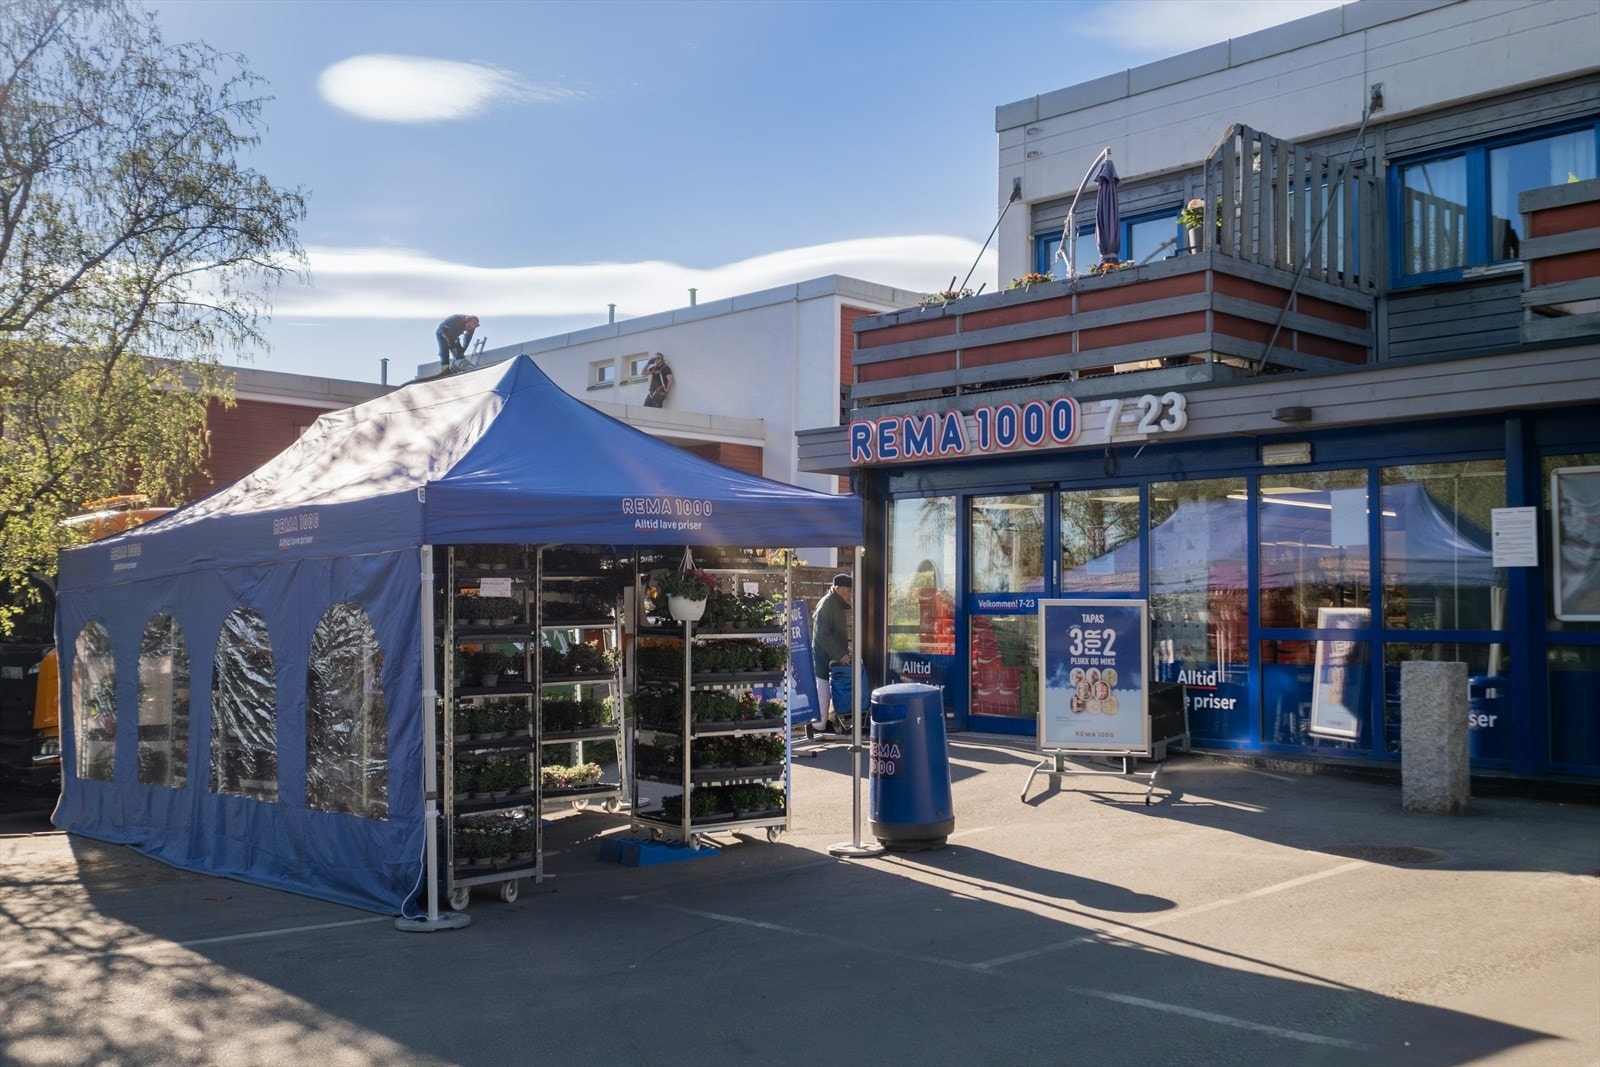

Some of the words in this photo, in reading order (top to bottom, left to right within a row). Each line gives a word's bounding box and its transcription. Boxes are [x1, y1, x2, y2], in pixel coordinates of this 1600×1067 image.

[848, 408, 967, 464] REMA
[975, 395, 1080, 451] 1000
[1100, 391, 1188, 437] 7-23
[622, 498, 672, 515] REMA
[675, 499, 713, 516] 1000
[634, 518, 659, 529] Alltid
[660, 519, 677, 529] lave
[678, 520, 703, 531] priser
[978, 599, 1018, 608] Velkommen!
[1019, 599, 1035, 608] 7-23
[1081, 614, 1105, 624] TAPAS
[1069, 628, 1083, 656] 3
[1084, 629, 1101, 655] FOR
[1102, 628, 1117, 656] 2
[902, 661, 932, 674] Alltid
[1070, 657, 1089, 665] PLUKK
[1100, 658, 1116, 666] MIKS
[1177, 669, 1217, 686] Alltid
[1194, 693, 1237, 711] priser
[1468, 713, 1498, 728] ser
